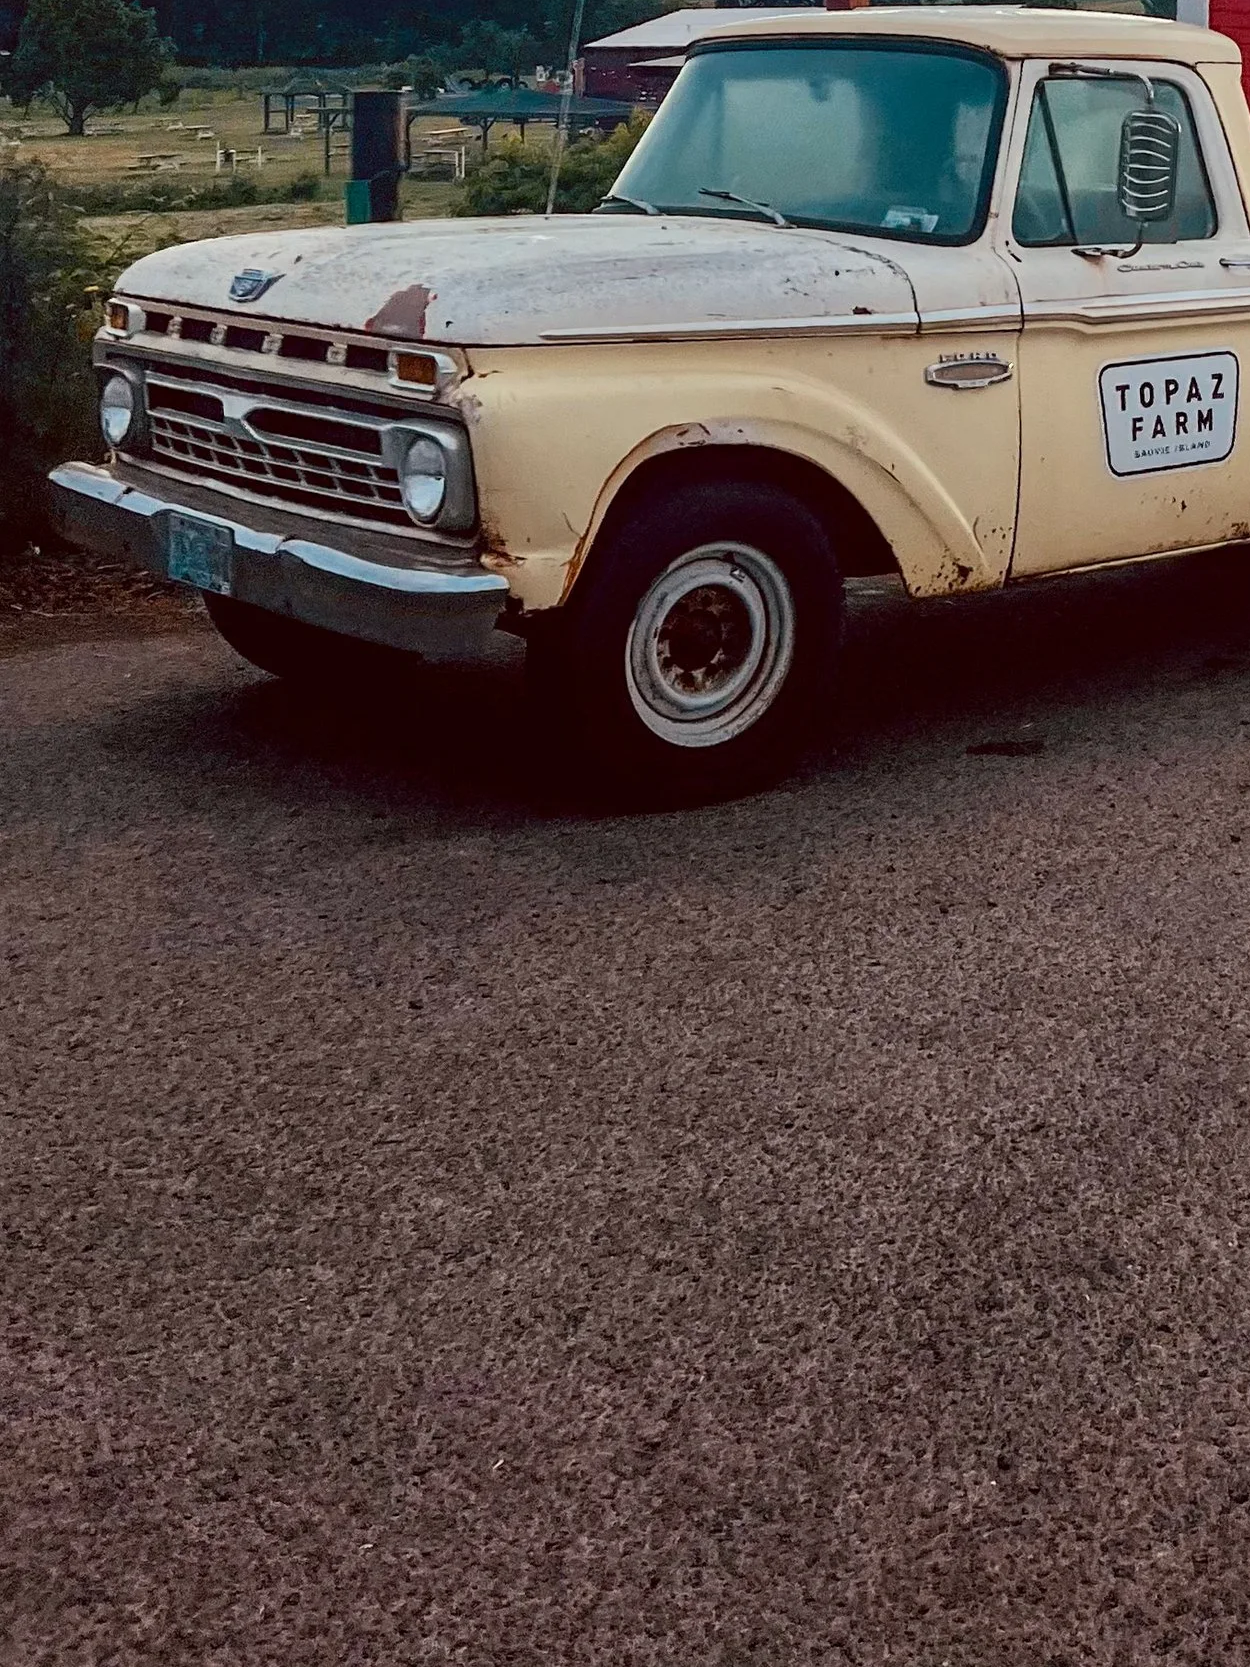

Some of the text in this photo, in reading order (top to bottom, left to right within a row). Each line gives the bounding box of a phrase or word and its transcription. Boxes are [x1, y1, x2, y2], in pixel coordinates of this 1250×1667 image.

[1115, 372, 1225, 412] TOPAZ
[1131, 408, 1214, 442] FARM
[1174, 440, 1212, 453] ISLAND
